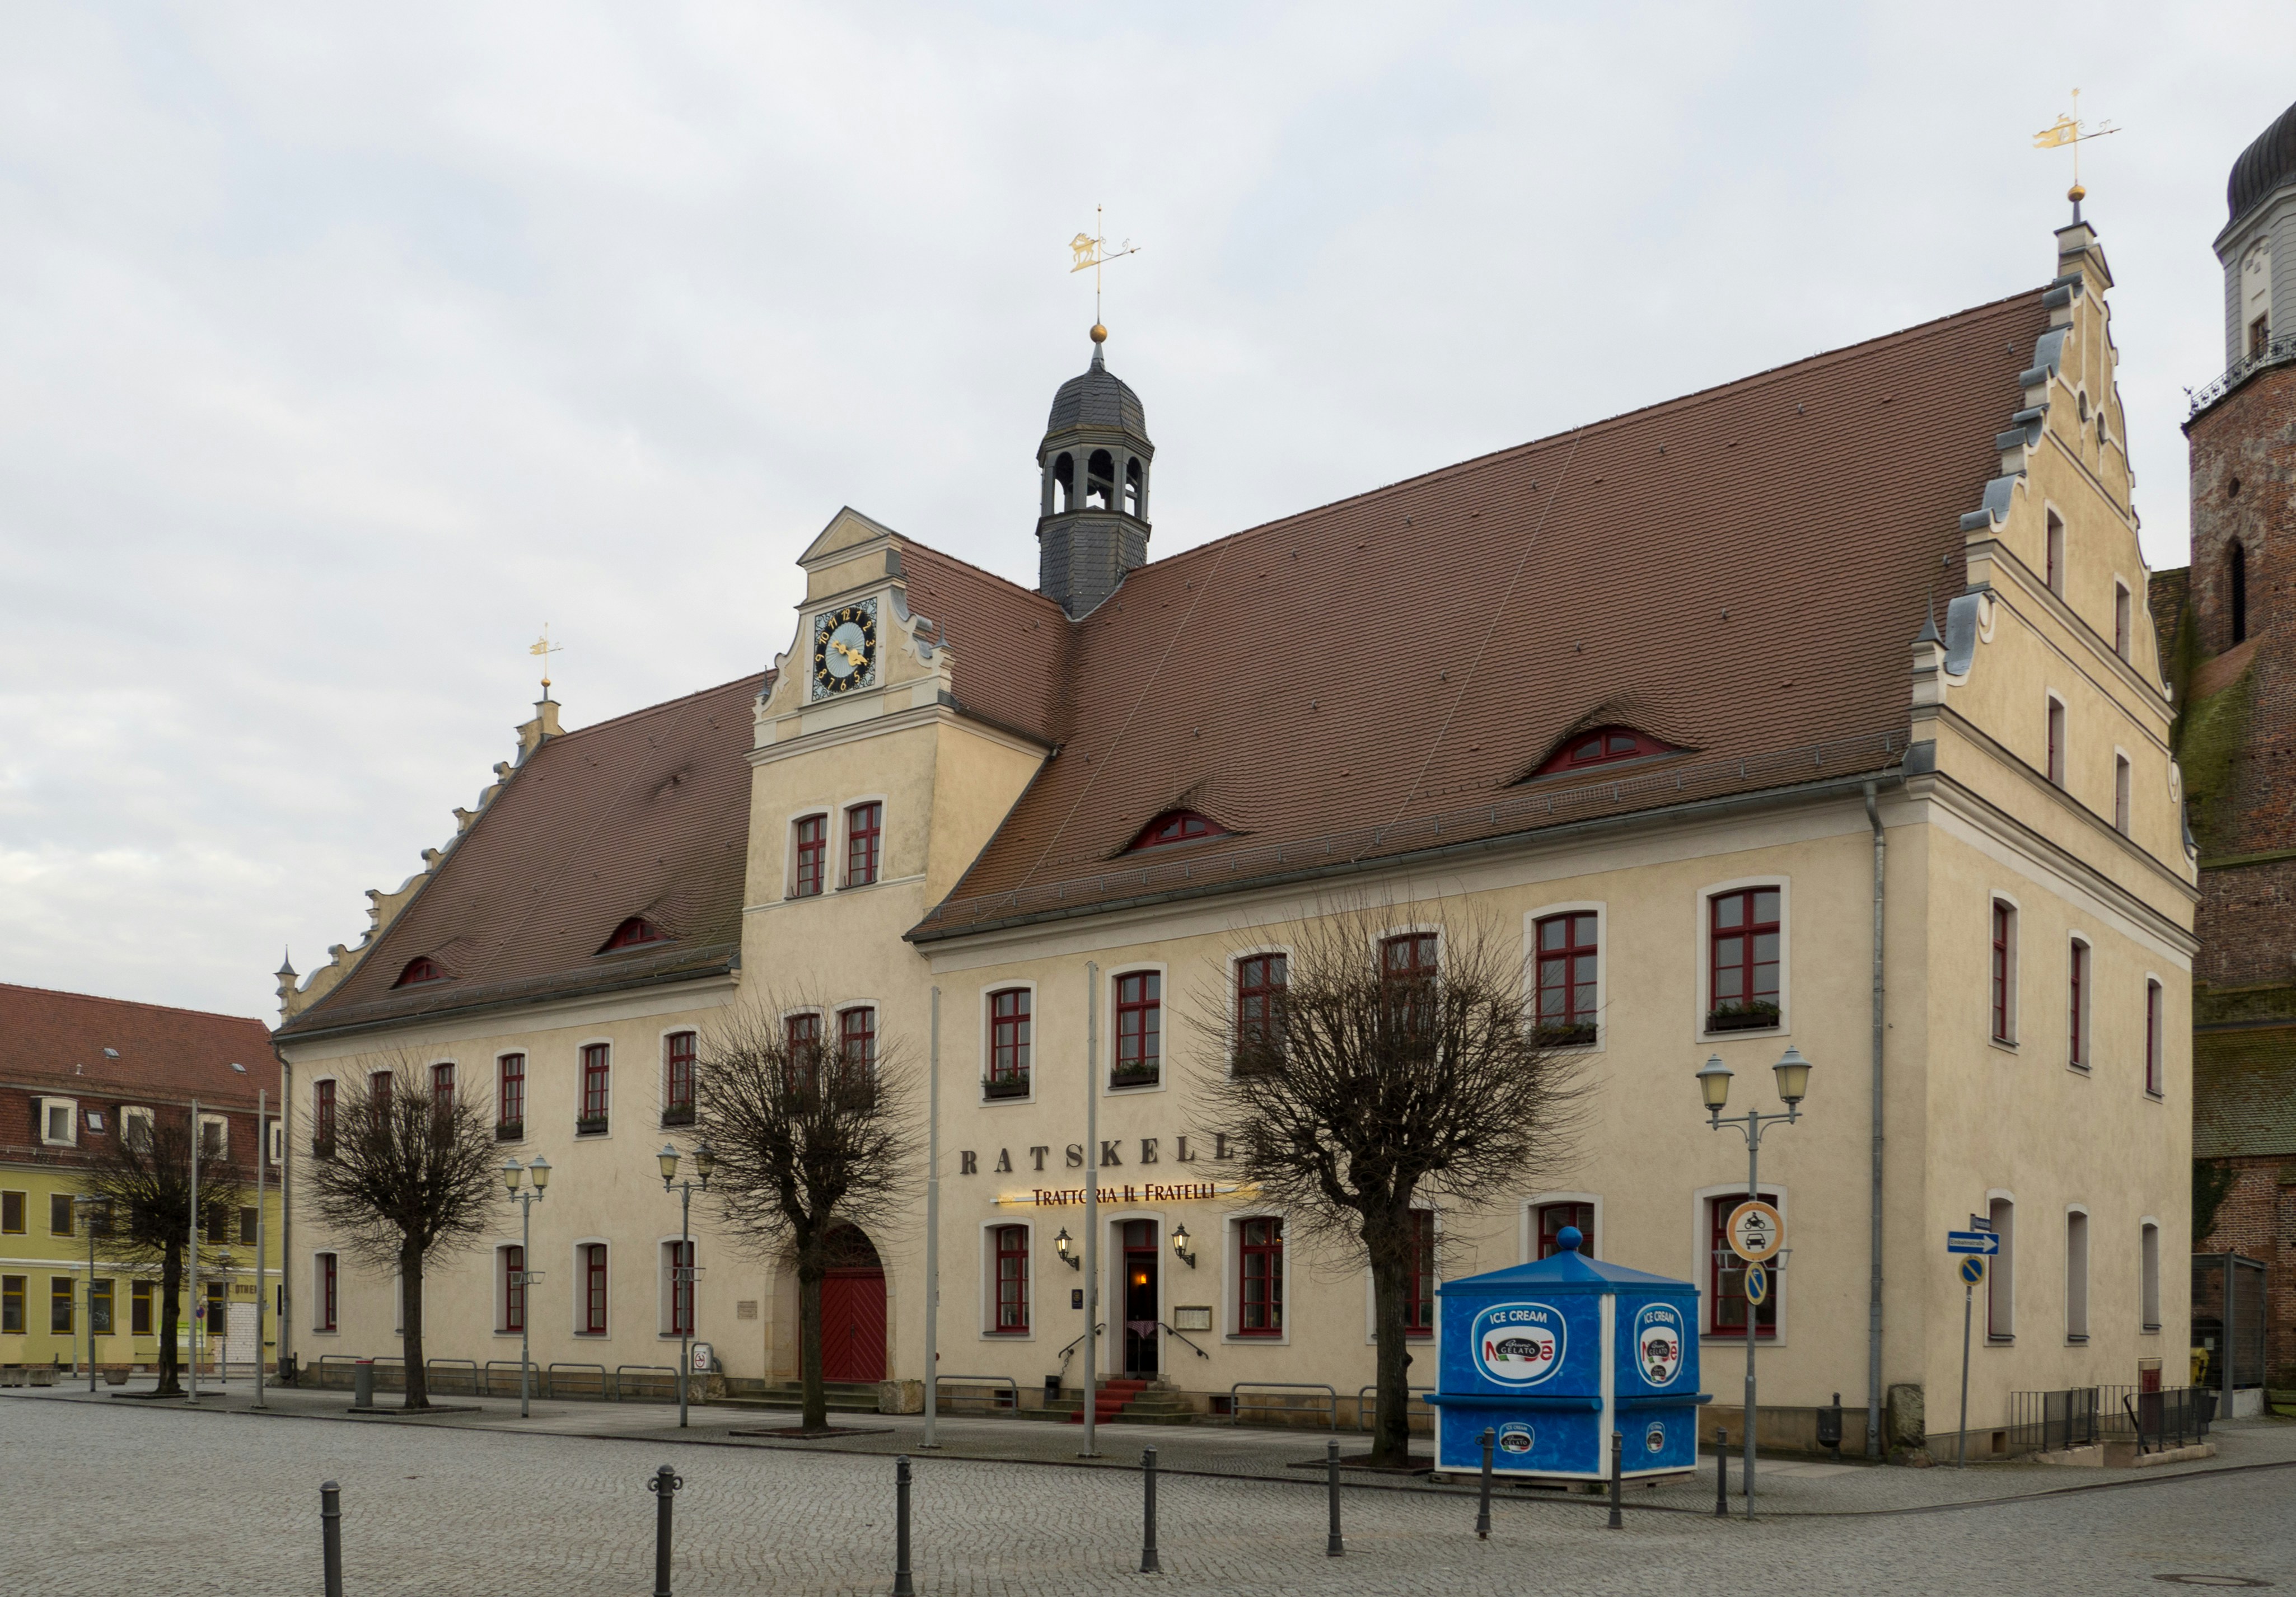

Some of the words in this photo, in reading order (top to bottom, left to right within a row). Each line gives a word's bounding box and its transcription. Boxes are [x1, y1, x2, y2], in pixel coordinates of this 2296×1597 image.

[841, 608, 850, 621] 12
[856, 610, 862, 621] 1
[828, 617, 838, 630] 11
[863, 621, 872, 632] 2
[819, 631, 829, 644] 10
[818, 668, 827, 678] 8
[854, 671, 860, 683] 5
[827, 677, 835, 690] 7
[840, 678, 847, 691] 6
[960, 1131, 1311, 1174] RATSKELL
[1145, 1183, 1215, 1201] FRATELLI
[1490, 1312, 1507, 1324] ICE
[1509, 1310, 1547, 1323] CREAM
[1644, 1312, 1653, 1324] ICE
[1654, 1310, 1675, 1324] CREAM
